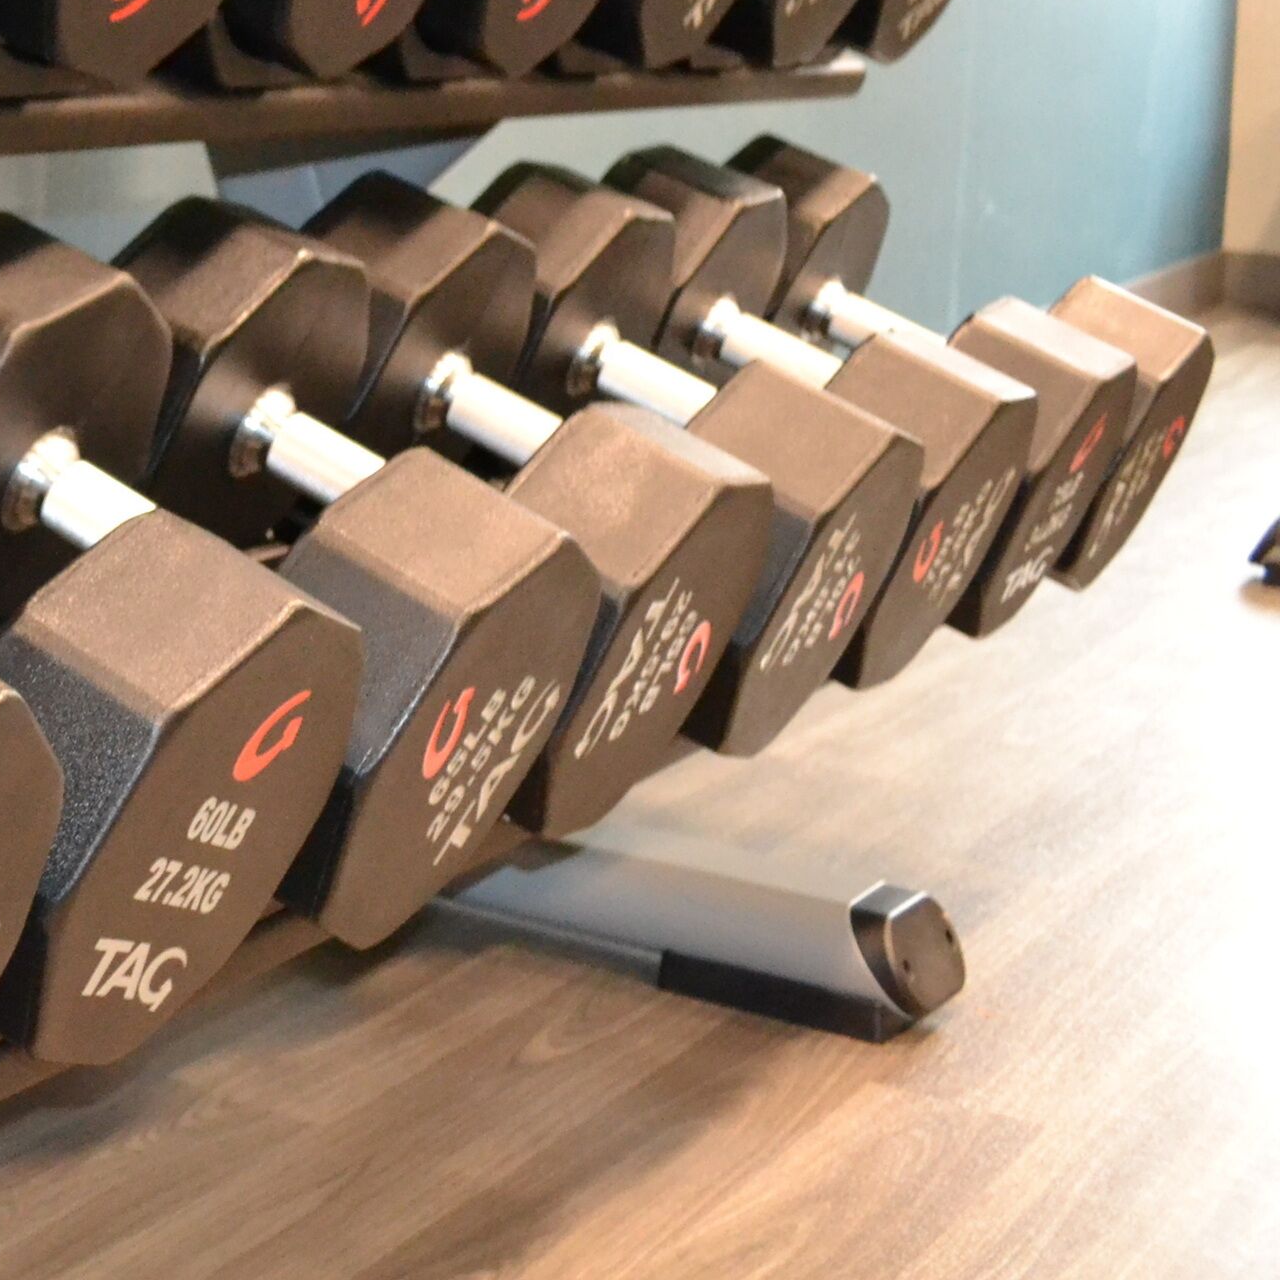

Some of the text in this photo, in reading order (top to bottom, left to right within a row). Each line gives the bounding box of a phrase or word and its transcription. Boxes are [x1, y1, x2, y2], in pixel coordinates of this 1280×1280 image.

[759, 511, 857, 673] TAG
[573, 577, 680, 760] TAG
[426, 674, 536, 843] 29.5KG
[428, 687, 507, 806] 65LB
[432, 678, 561, 867] TAG
[133, 856, 232, 915] 27.2KG
[186, 795, 256, 850] 60LB
[80, 936, 189, 1013] TAG
